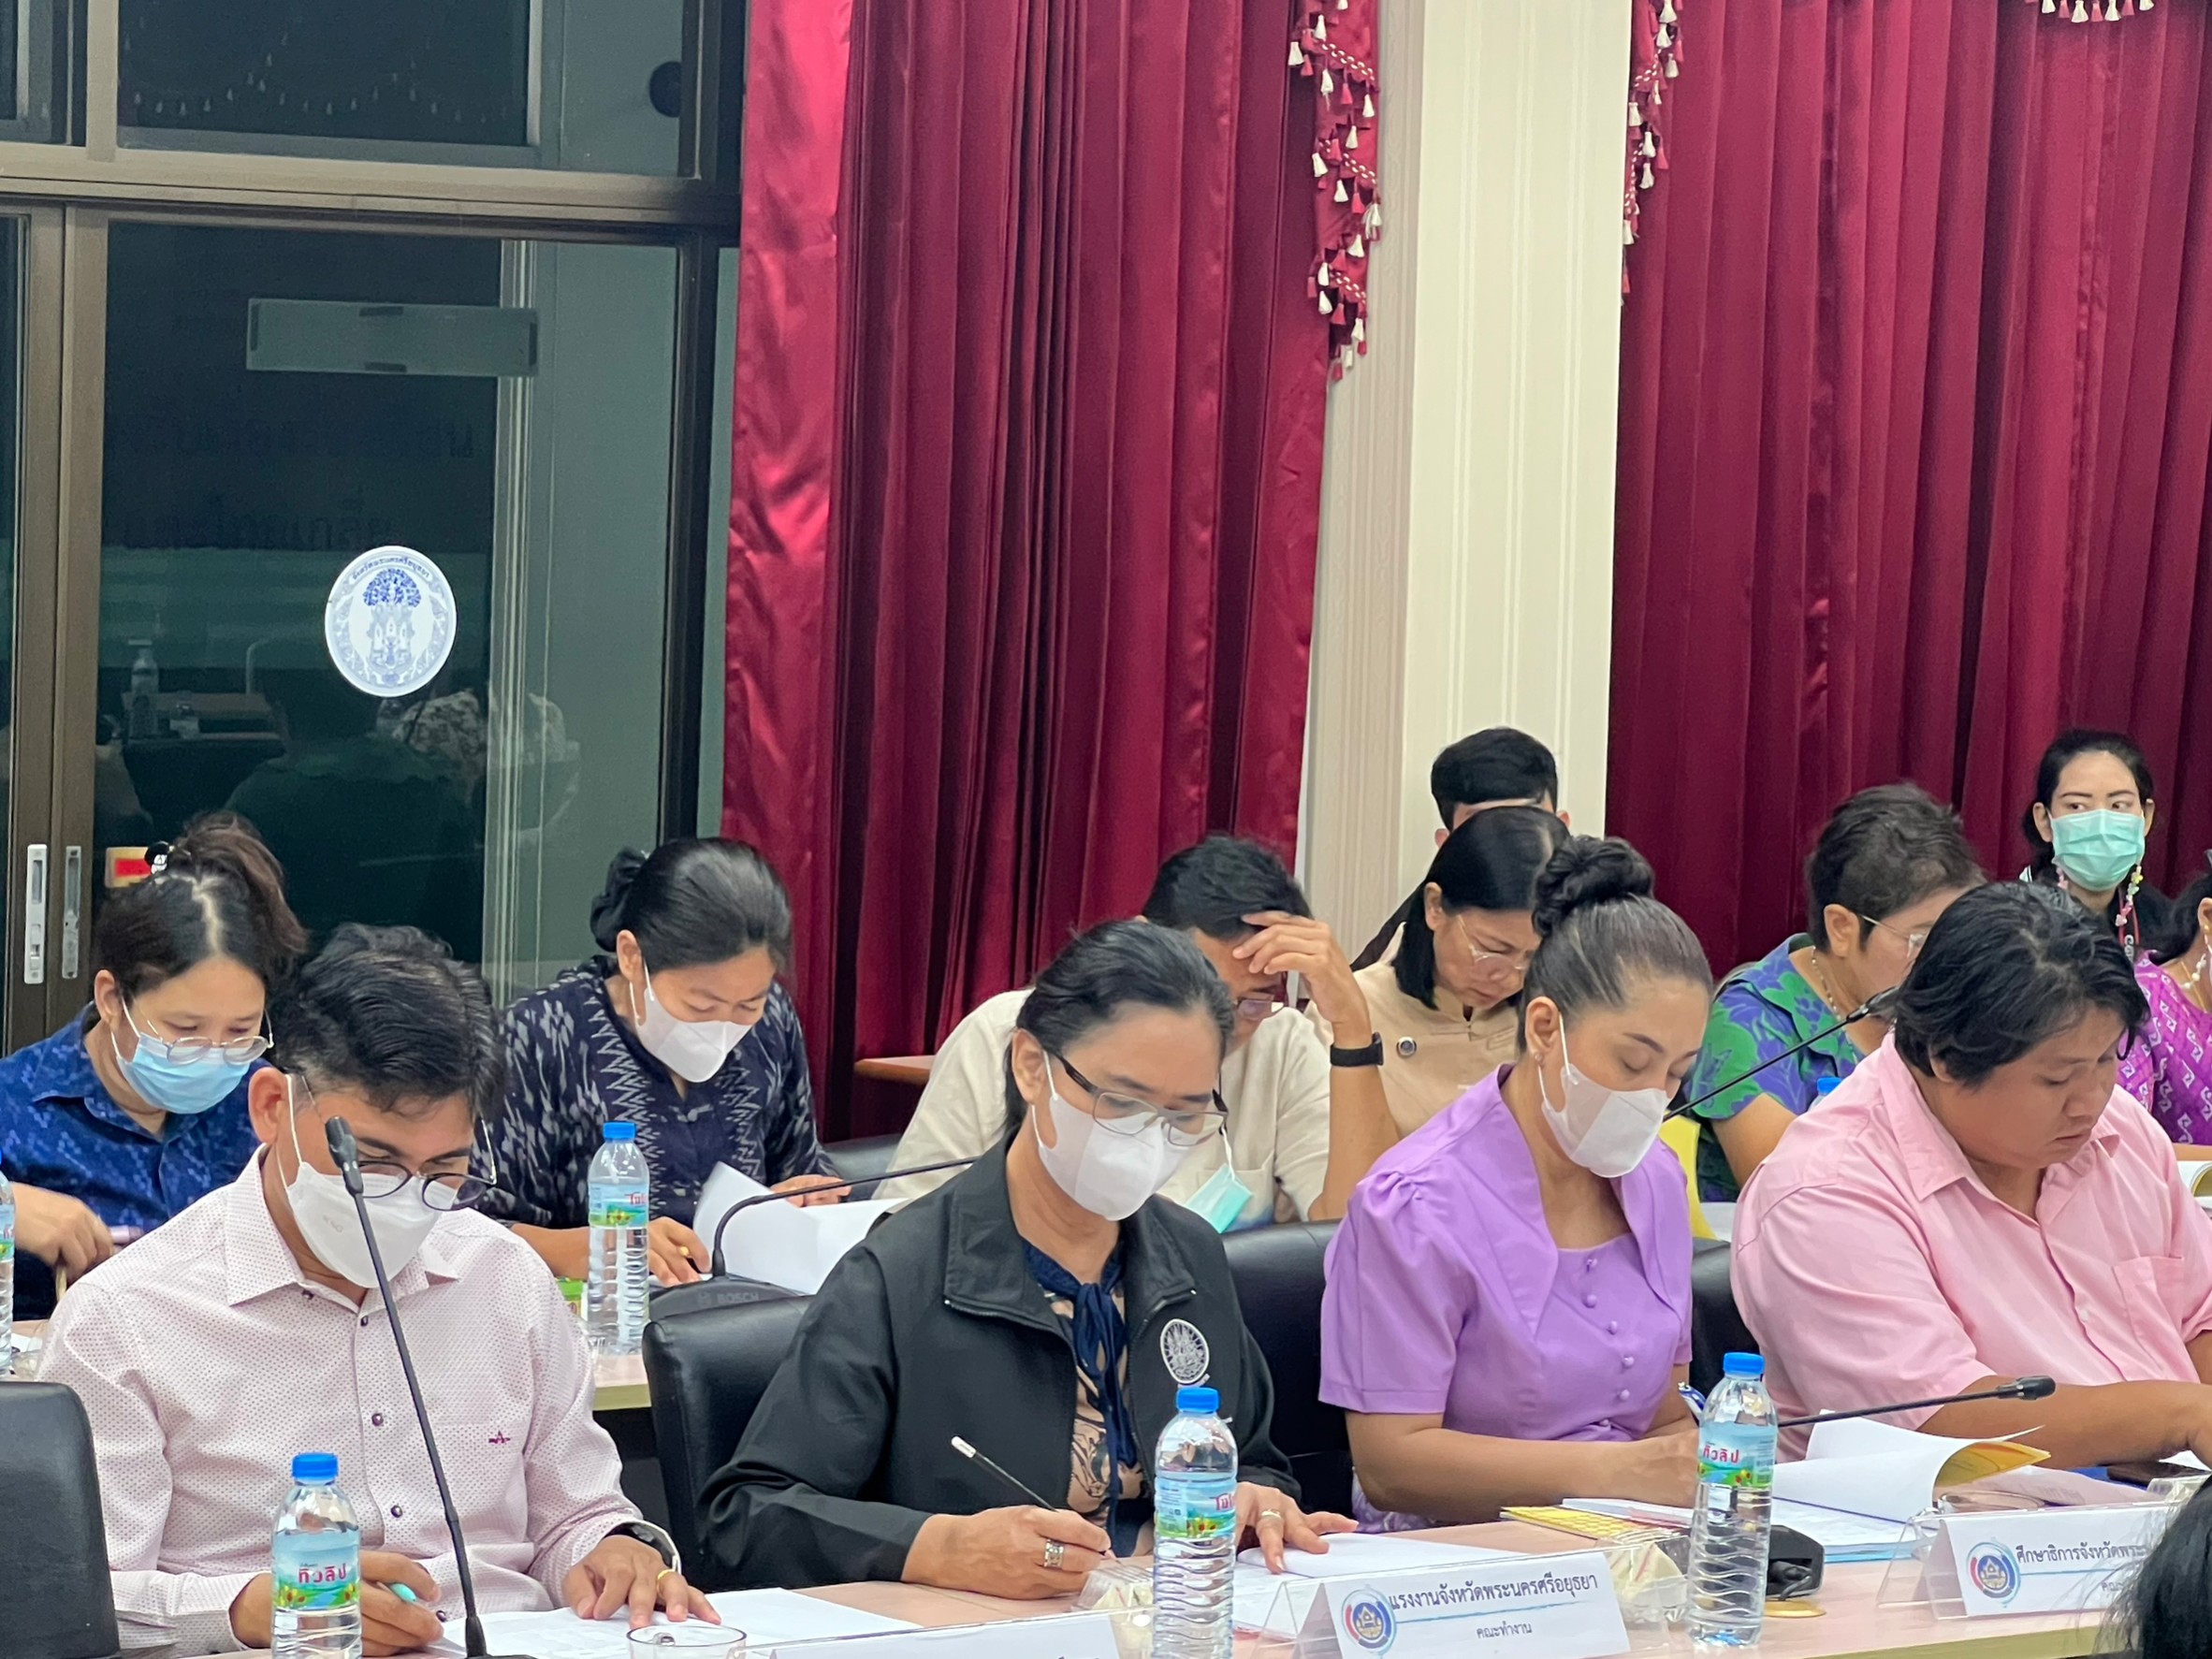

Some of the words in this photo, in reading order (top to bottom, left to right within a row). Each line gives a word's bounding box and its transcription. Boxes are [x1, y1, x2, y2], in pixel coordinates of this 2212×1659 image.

[717, 1292, 760, 1304] BOSCH
[1702, 1445, 1739, 1464] ทิวลิป
[2016, 1540, 2147, 1564] ศึกษาธิการจังหวัดพระ
[298, 1564, 347, 1584] ทิวลิป
[1389, 1572, 1599, 1610] แรงงานจังหวัดพระนครศรีอยุธยา
[1476, 1621, 1534, 1639] คณะทำงาน
